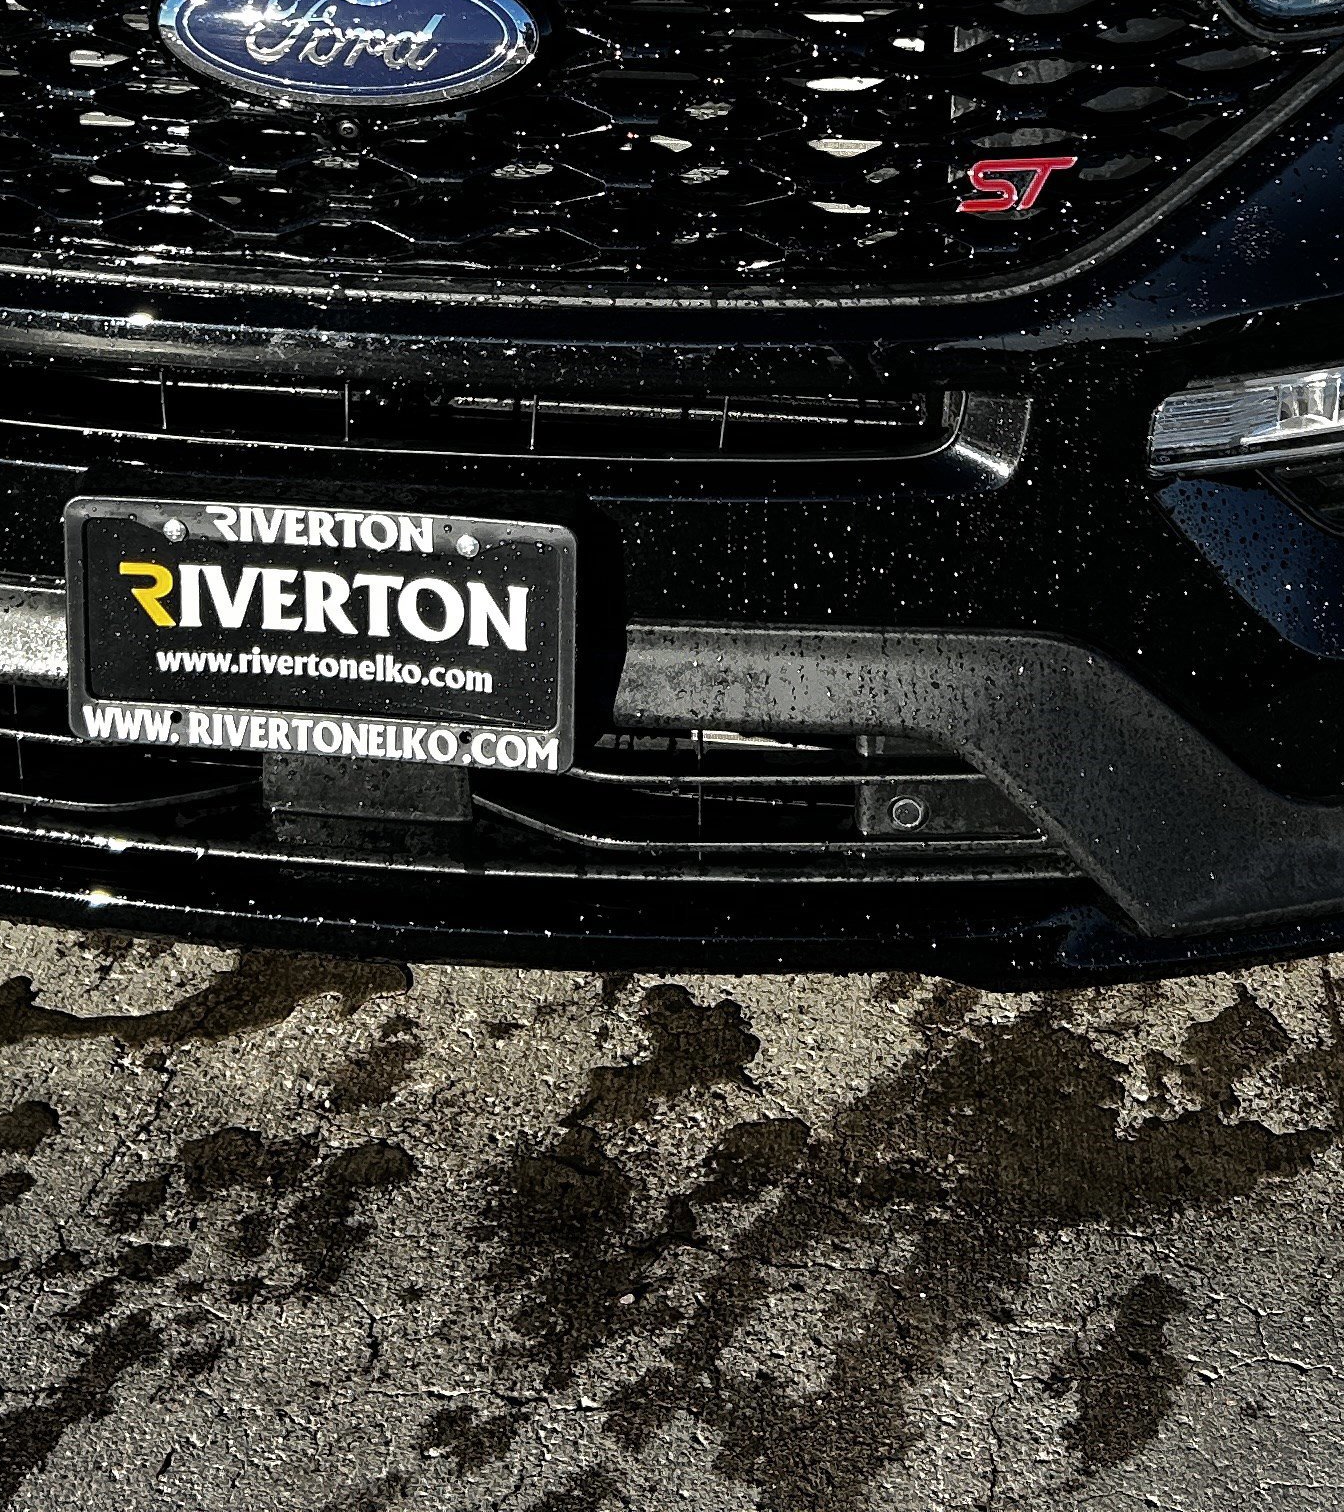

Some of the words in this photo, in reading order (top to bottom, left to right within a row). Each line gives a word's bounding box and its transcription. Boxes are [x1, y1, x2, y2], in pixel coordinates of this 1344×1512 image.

[956, 156, 1078, 213] ST
[205, 505, 434, 554] RIVERTON
[118, 561, 531, 652] RIVERTON
[156, 646, 494, 694] www.rivertonelko.com
